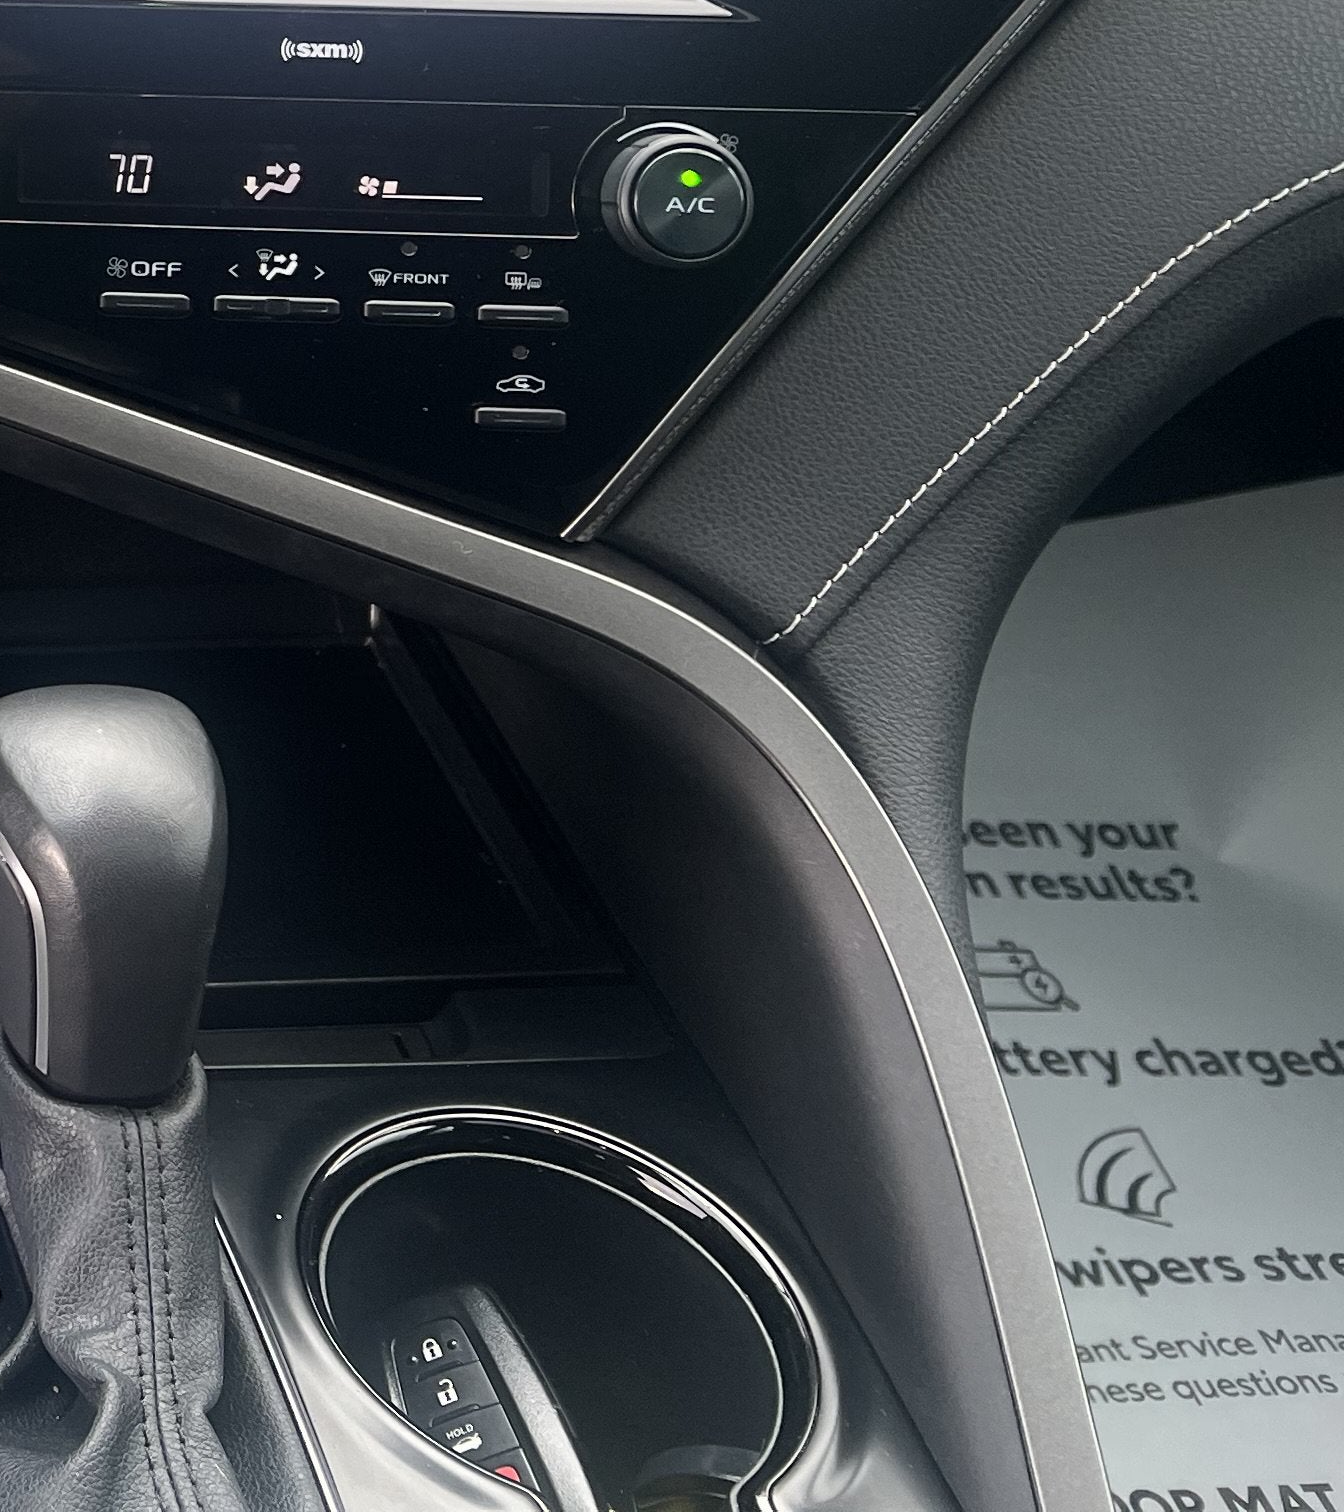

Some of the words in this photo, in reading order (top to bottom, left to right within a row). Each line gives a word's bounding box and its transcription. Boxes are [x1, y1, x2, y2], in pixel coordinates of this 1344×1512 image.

[110, 153, 154, 194] 70
[665, 196, 716, 215] A/C
[130, 261, 182, 278] OFF
[393, 273, 450, 286] FRONT
[1065, 821, 1179, 859] your
[1007, 864, 1201, 904] results?
[1135, 1037, 1344, 1088] charged
[1055, 1246, 1246, 1297] wipers
[1132, 1331, 1257, 1360] Service
[1172, 1369, 1339, 1407] questions
[445, 1423, 474, 1441] HOLD
